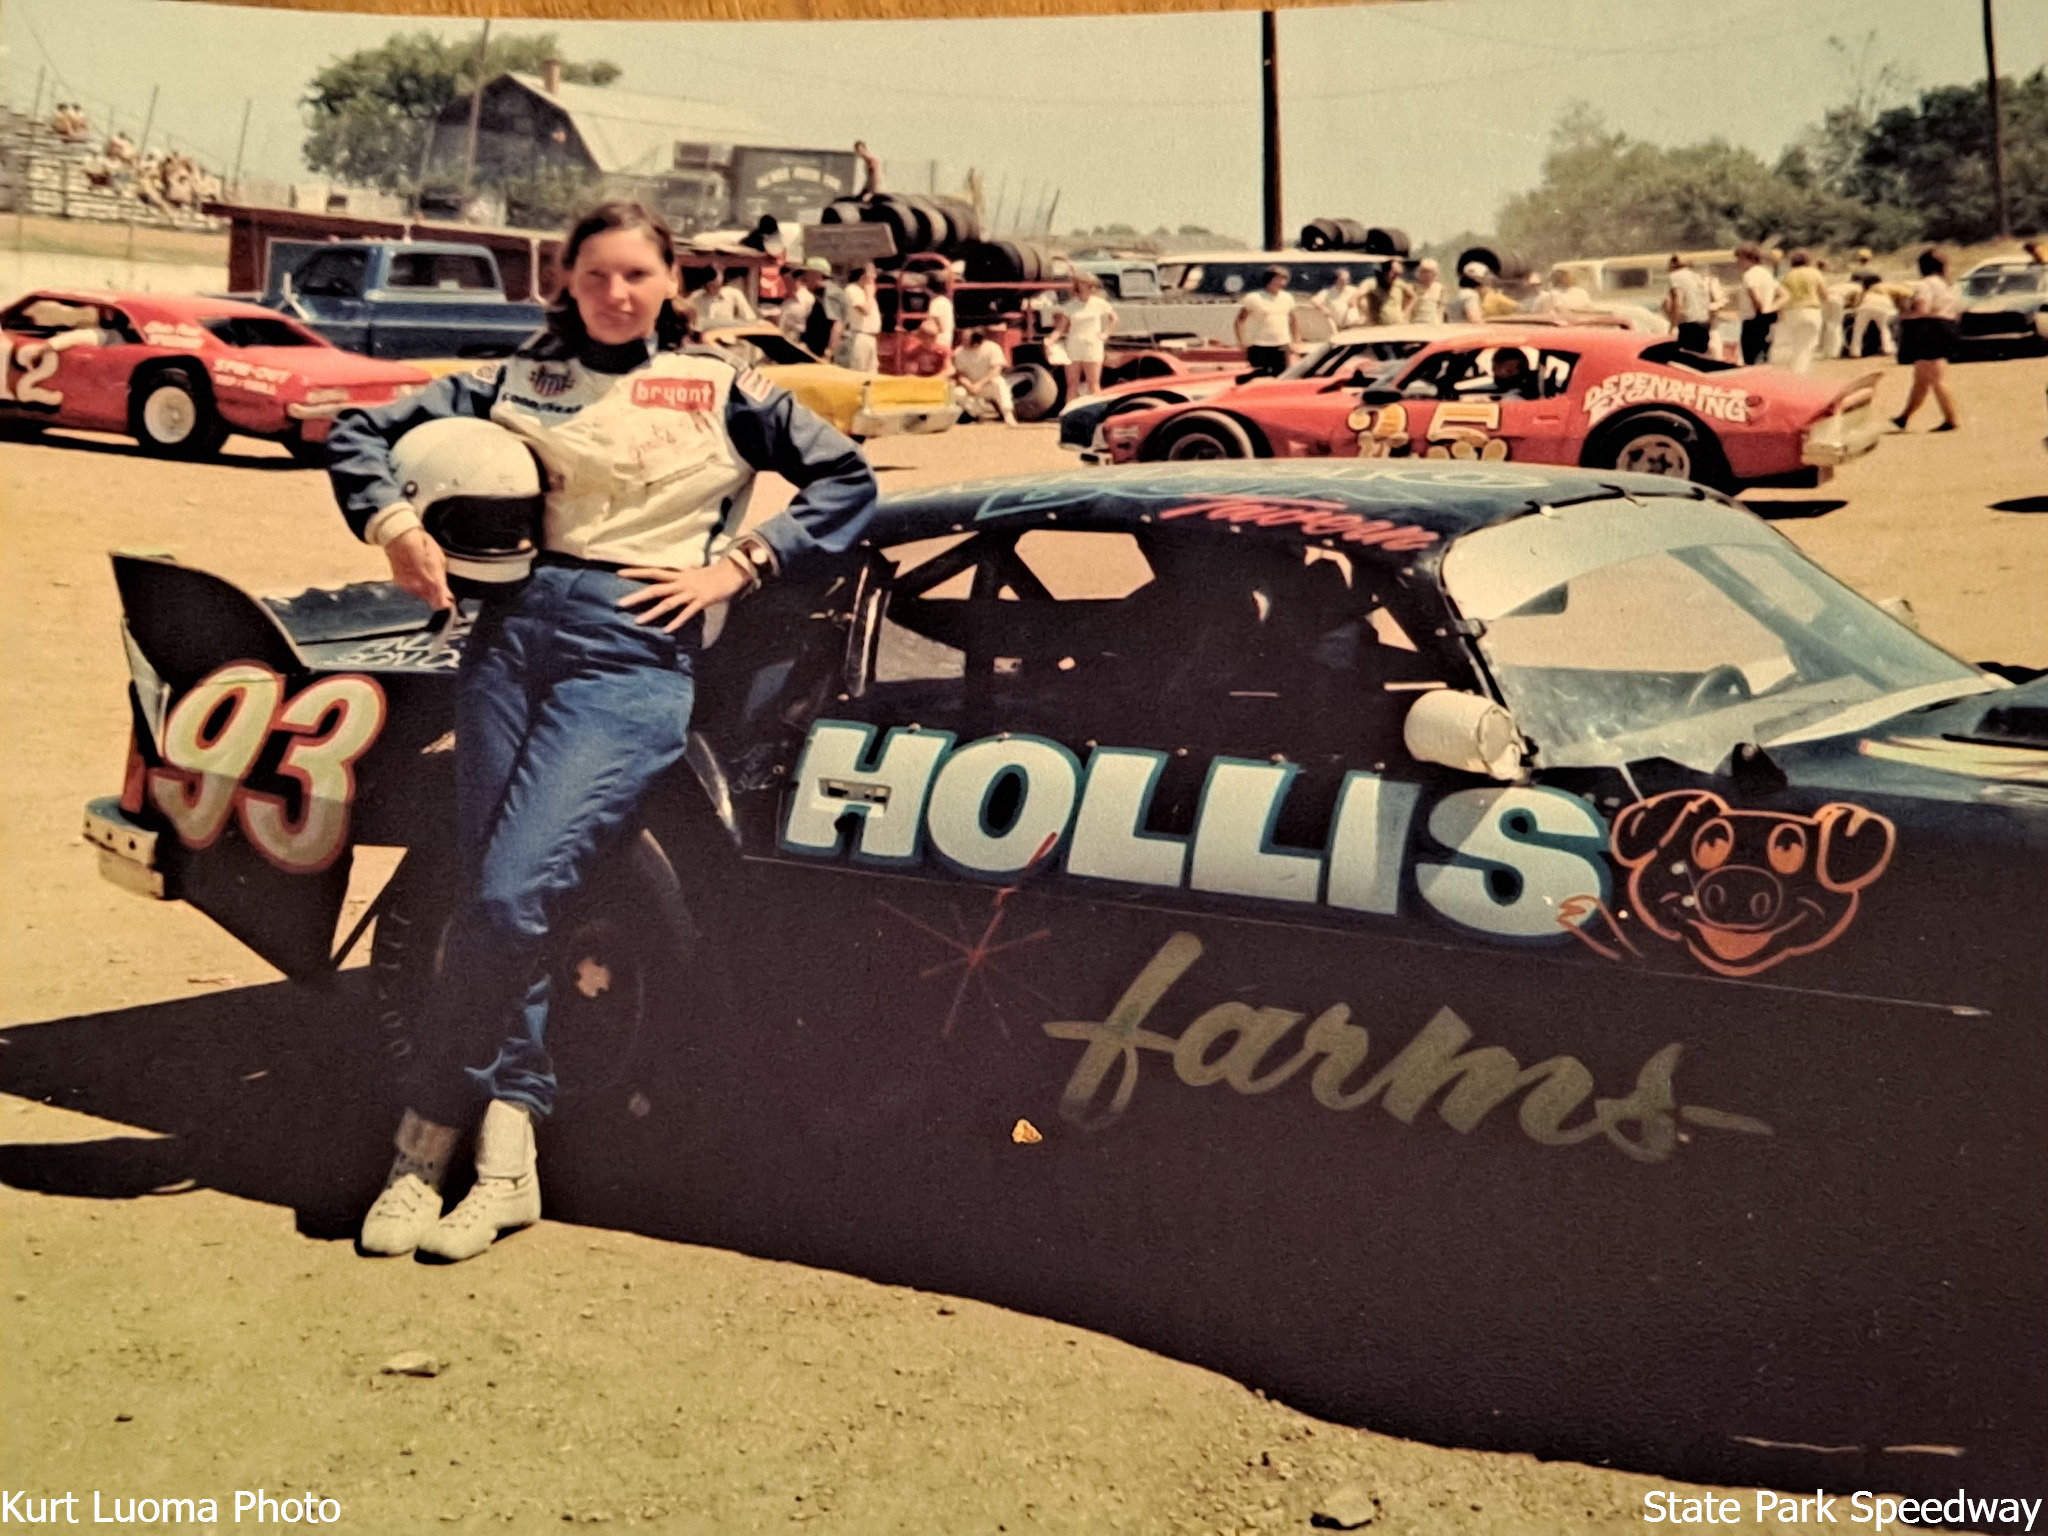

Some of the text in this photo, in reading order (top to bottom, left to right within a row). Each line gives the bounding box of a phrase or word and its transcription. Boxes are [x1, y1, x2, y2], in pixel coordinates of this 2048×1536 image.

[636, 380, 712, 407] bryant
[147, 659, 388, 874] 93
[781, 720, 1614, 938] HOLLIS
[1043, 930, 1776, 1166] farms
